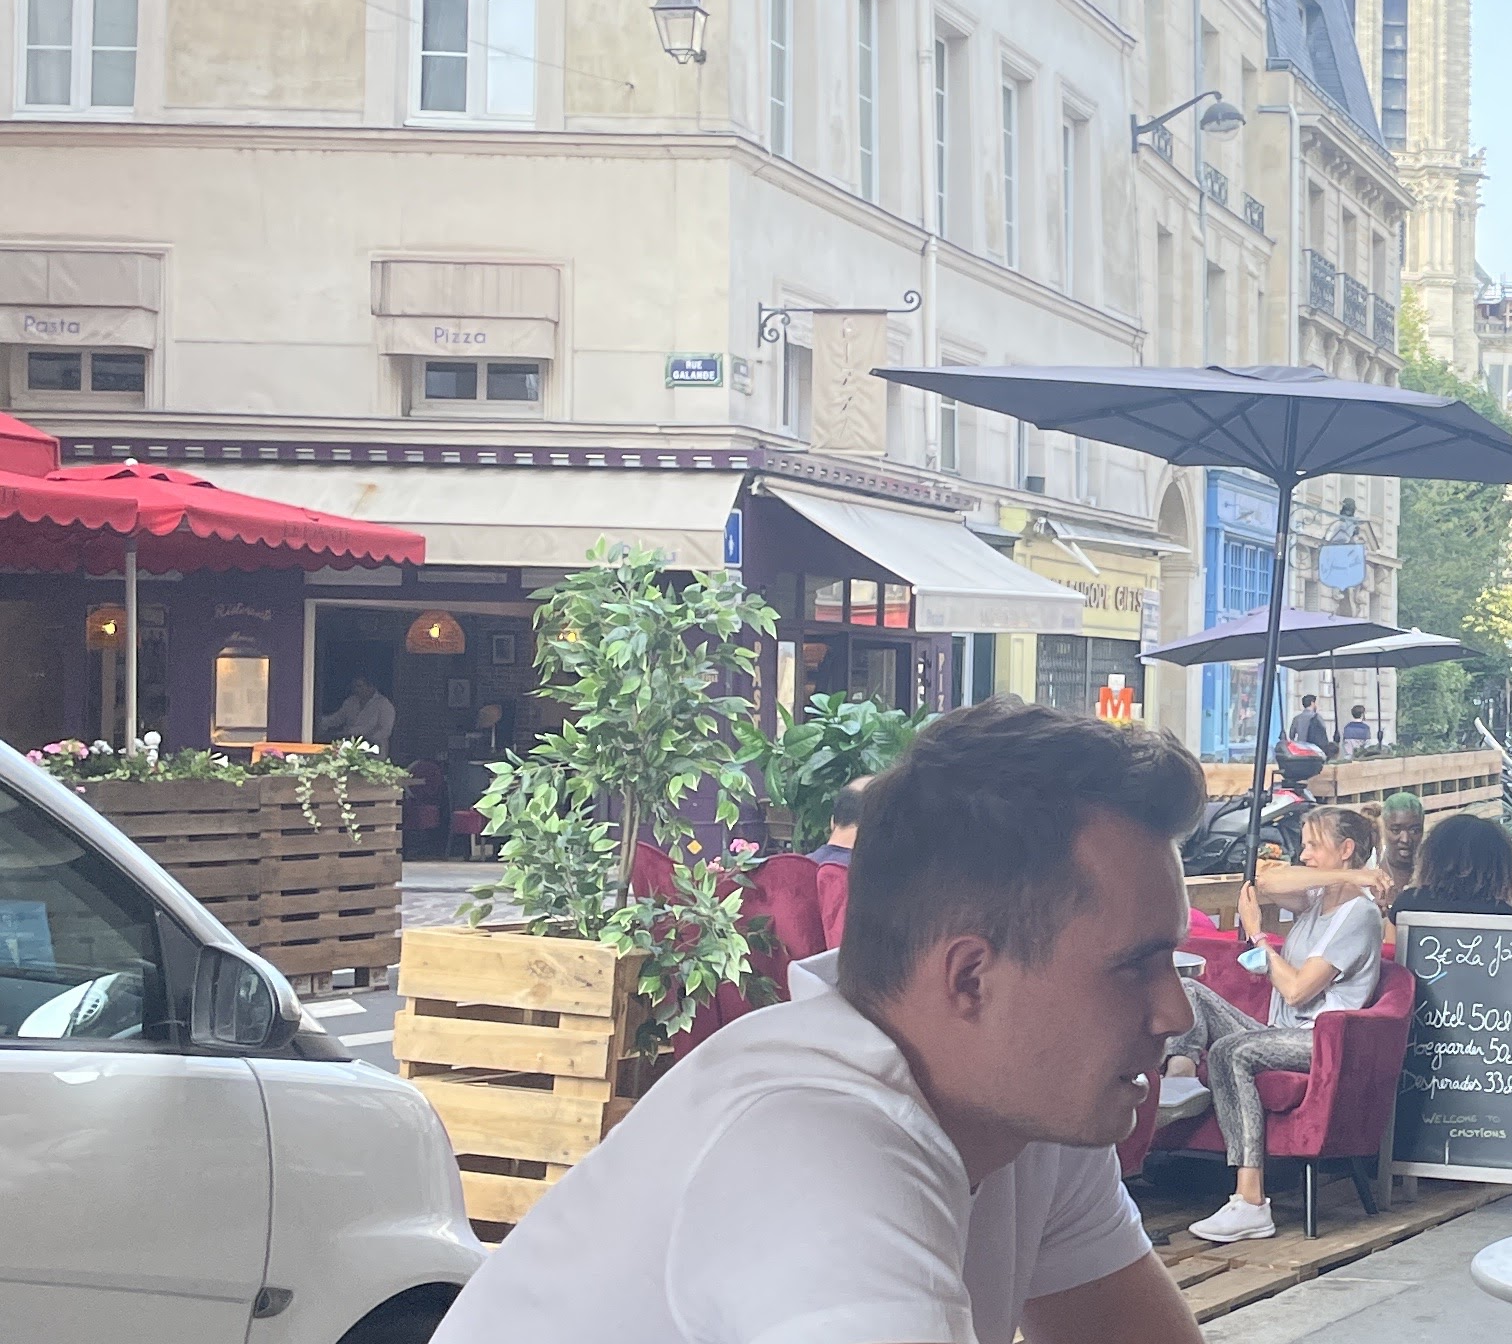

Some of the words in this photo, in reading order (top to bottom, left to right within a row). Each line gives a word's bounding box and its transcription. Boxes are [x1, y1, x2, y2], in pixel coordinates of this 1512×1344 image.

[24, 315, 81, 334] Pasta
[434, 326, 486, 344] Pizza
[685, 360, 703, 370] RUE
[672, 370, 716, 380] GALANDE
[1415, 936, 1453, 979] 3€
[1455, 935, 1484, 966] La
[1411, 999, 1466, 1030] Kastel
[1399, 1069, 1483, 1100] Desperados
[1422, 1112, 1477, 1124] WELCOME
[1485, 1114, 1501, 1123] TO
[1449, 1127, 1507, 1139] EMOTIONS
